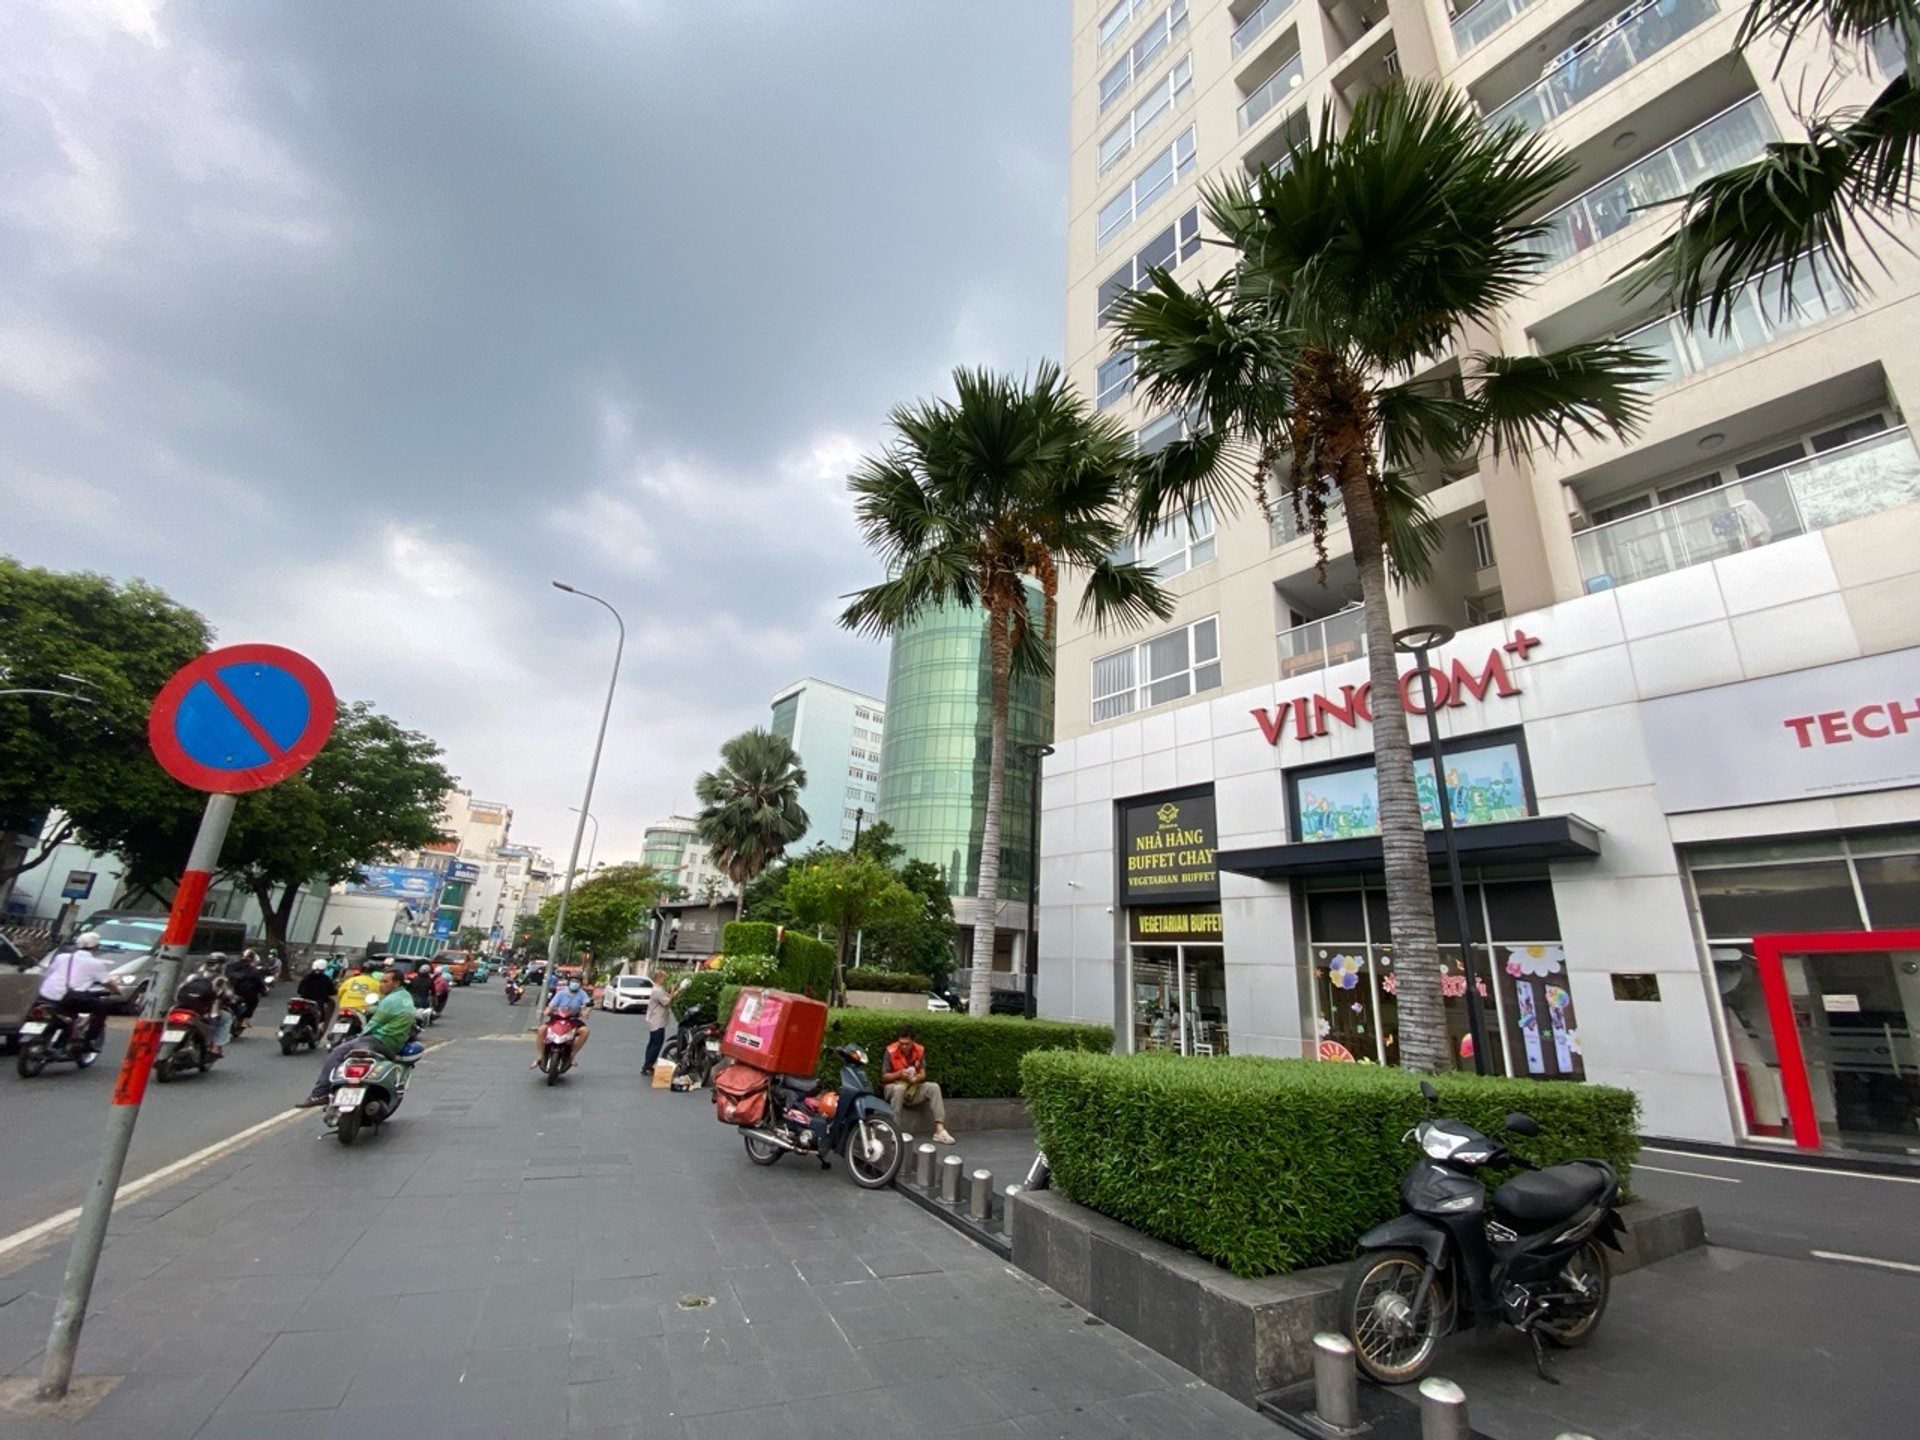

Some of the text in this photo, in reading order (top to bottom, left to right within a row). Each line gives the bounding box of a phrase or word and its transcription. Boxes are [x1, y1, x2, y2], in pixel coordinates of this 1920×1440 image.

[1783, 697, 1920, 748] TECH
[1136, 828, 1203, 851] NHÀ HÀNG
[1128, 849, 1214, 870] BUFFET CHAY
[1128, 872, 1216, 886] VEGETARIAN BUFFET
[1139, 915, 1189, 933] VEGETARIAN
